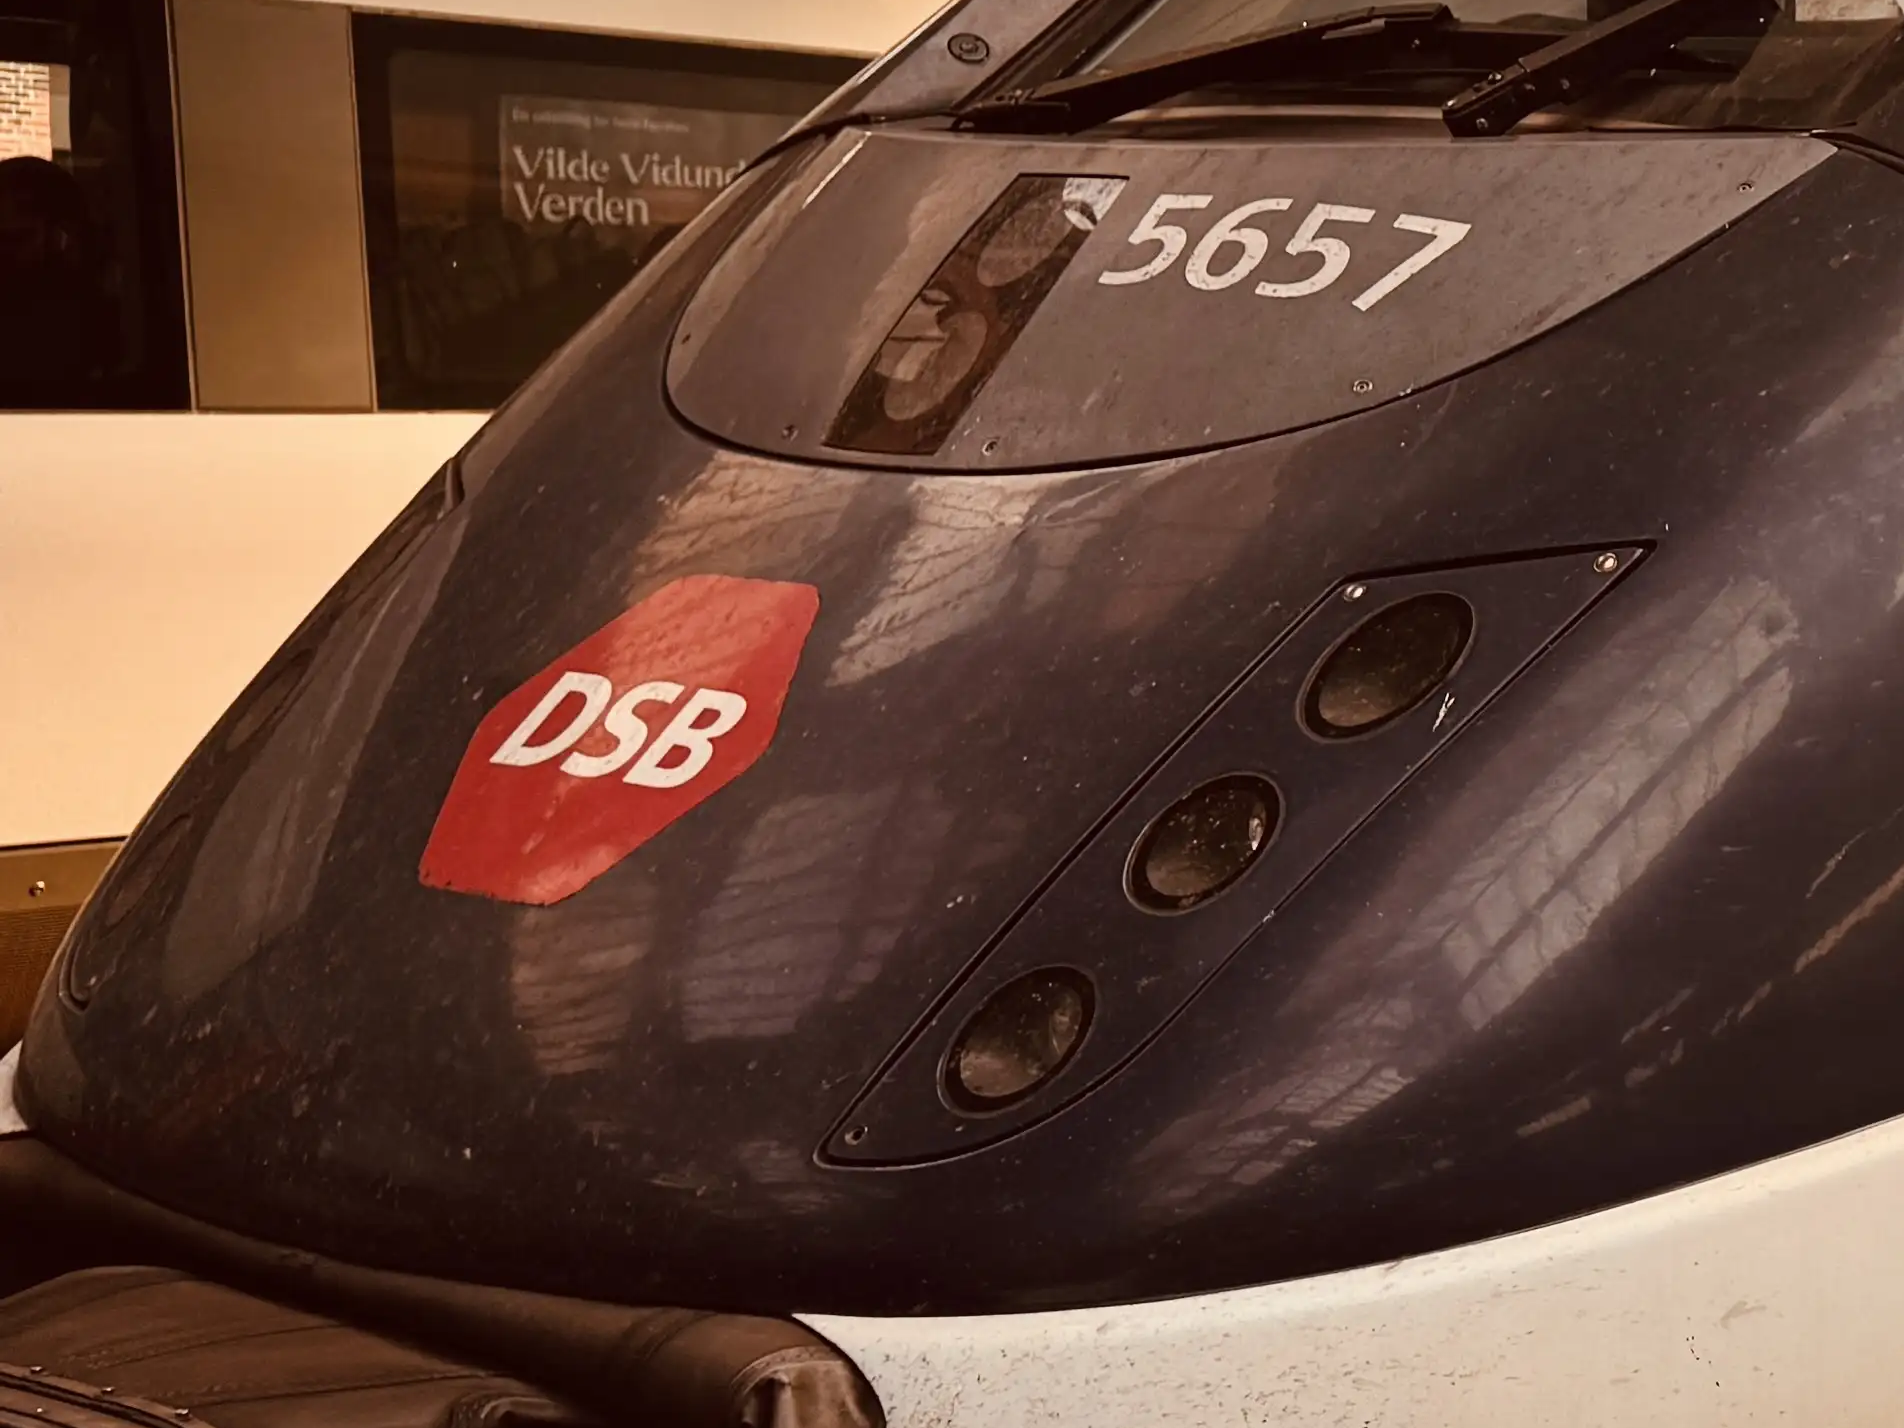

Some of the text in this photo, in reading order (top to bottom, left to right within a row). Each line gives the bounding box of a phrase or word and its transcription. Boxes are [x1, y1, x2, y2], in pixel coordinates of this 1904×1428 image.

[512, 145, 610, 183] Vilde
[513, 182, 649, 227] Verden
[1098, 194, 1472, 312] 5657
[489, 671, 747, 789] DSB
